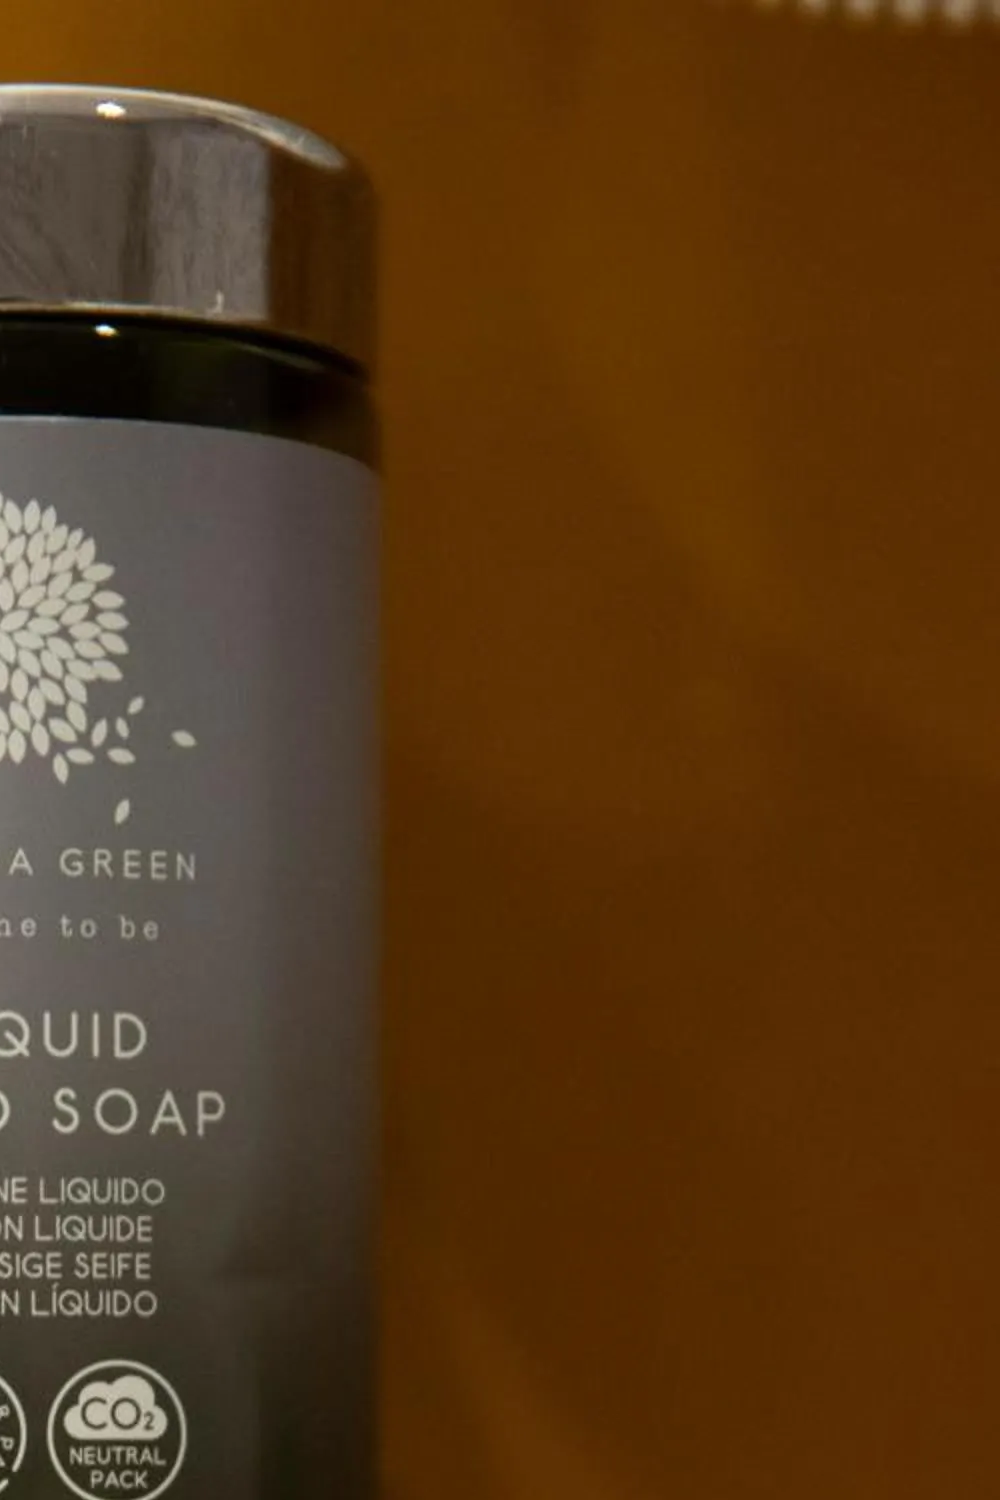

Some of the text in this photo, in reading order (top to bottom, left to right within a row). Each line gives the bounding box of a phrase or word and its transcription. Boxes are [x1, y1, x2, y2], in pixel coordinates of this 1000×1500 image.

[60, 848, 196, 880] GREEN
[61, 915, 96, 939] to
[120, 915, 159, 940] be
[52, 1087, 225, 1136] SOAP
[39, 1178, 164, 1205] LIQUIDO
[35, 1215, 153, 1242] LIQUIDE
[74, 1252, 151, 1280] SEIFE
[31, 1283, 157, 1317] LÍQUIDO
[70, 1446, 166, 1466] NEUTRAL
[91, 1471, 148, 1489] PACK
